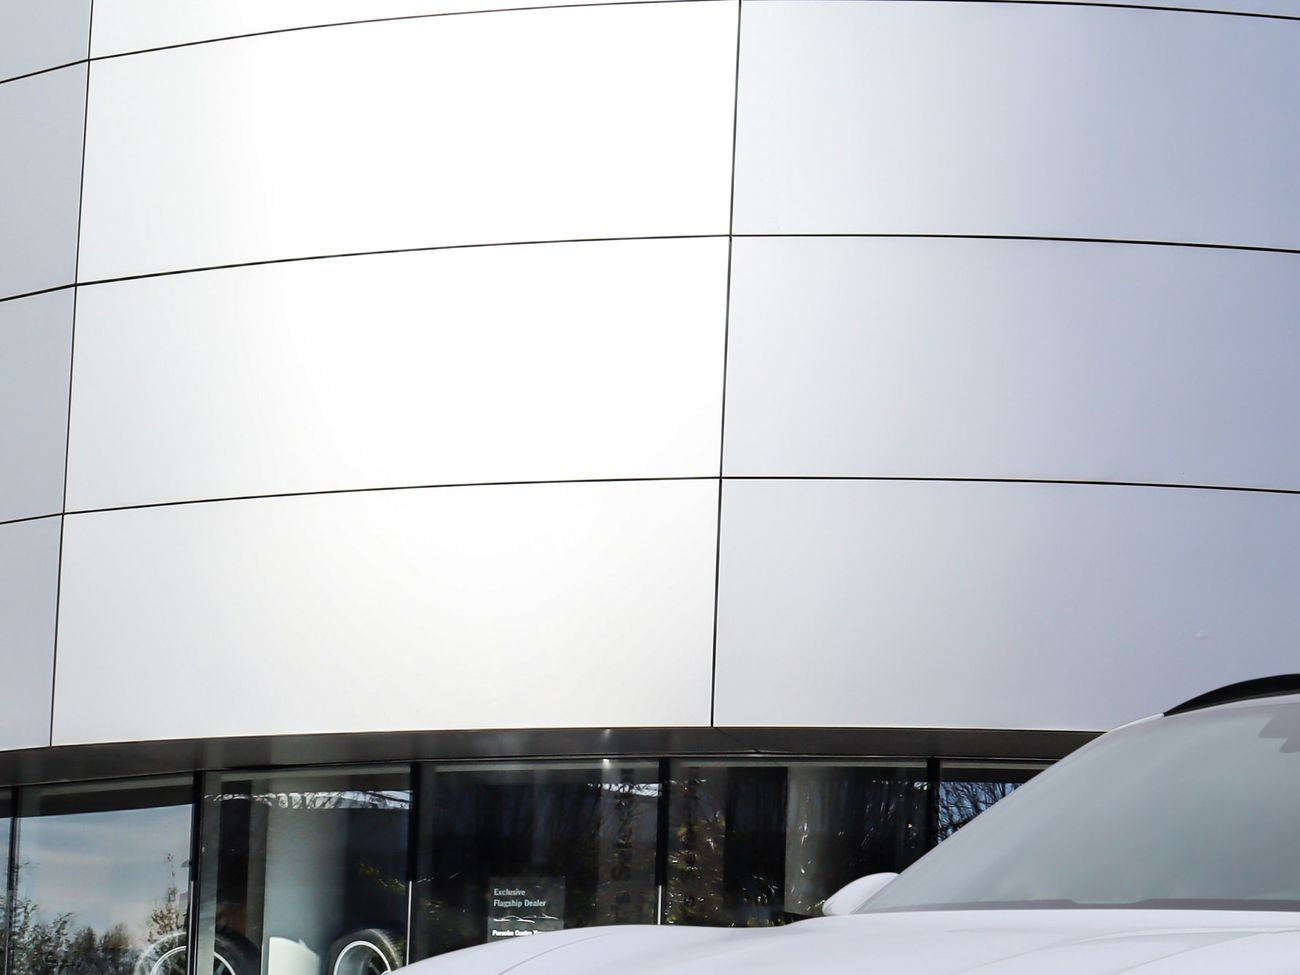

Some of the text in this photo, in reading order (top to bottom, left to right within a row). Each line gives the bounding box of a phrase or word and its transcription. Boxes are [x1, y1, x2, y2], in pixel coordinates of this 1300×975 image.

[493, 888, 526, 896] Exclusive
[493, 899, 547, 908] Flagship Dealer
